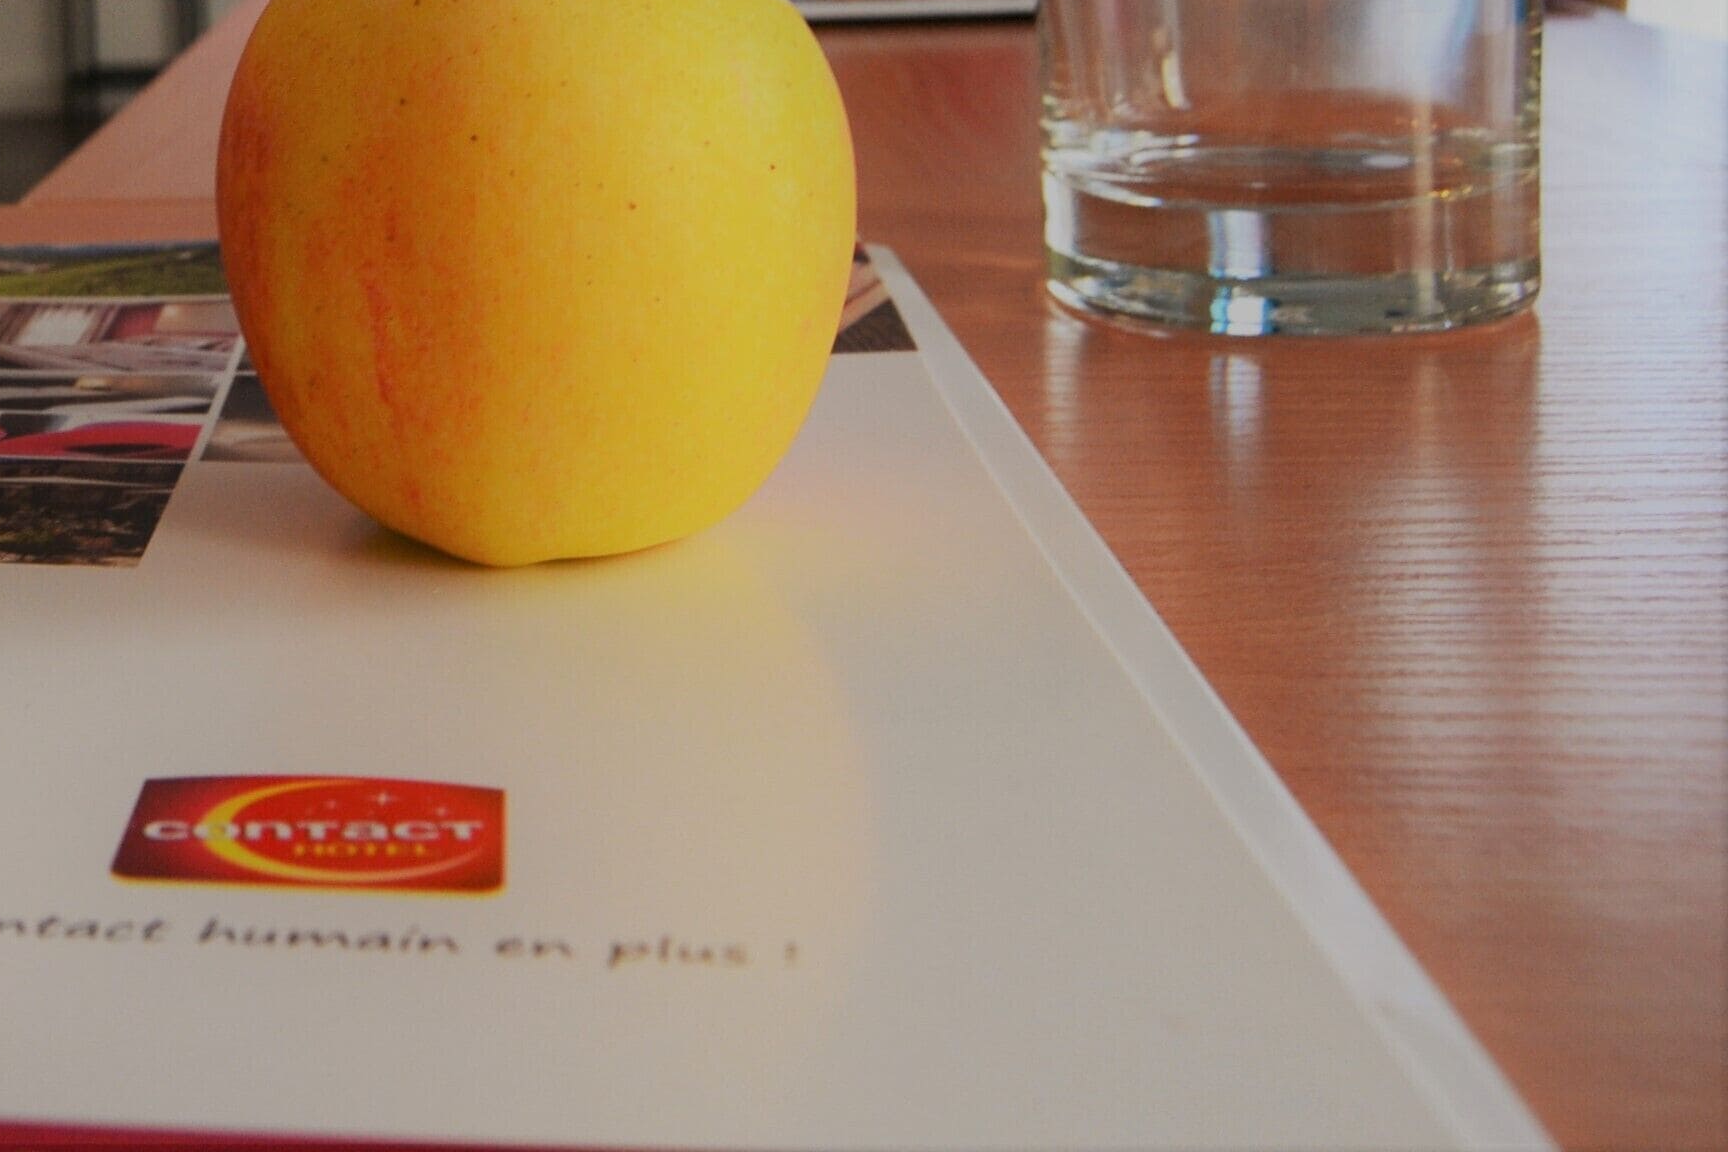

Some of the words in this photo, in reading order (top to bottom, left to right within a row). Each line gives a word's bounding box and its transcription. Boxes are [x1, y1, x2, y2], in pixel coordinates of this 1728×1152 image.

[197, 917, 460, 954] humain
[494, 935, 572, 959] en
[604, 935, 750, 970] plus
